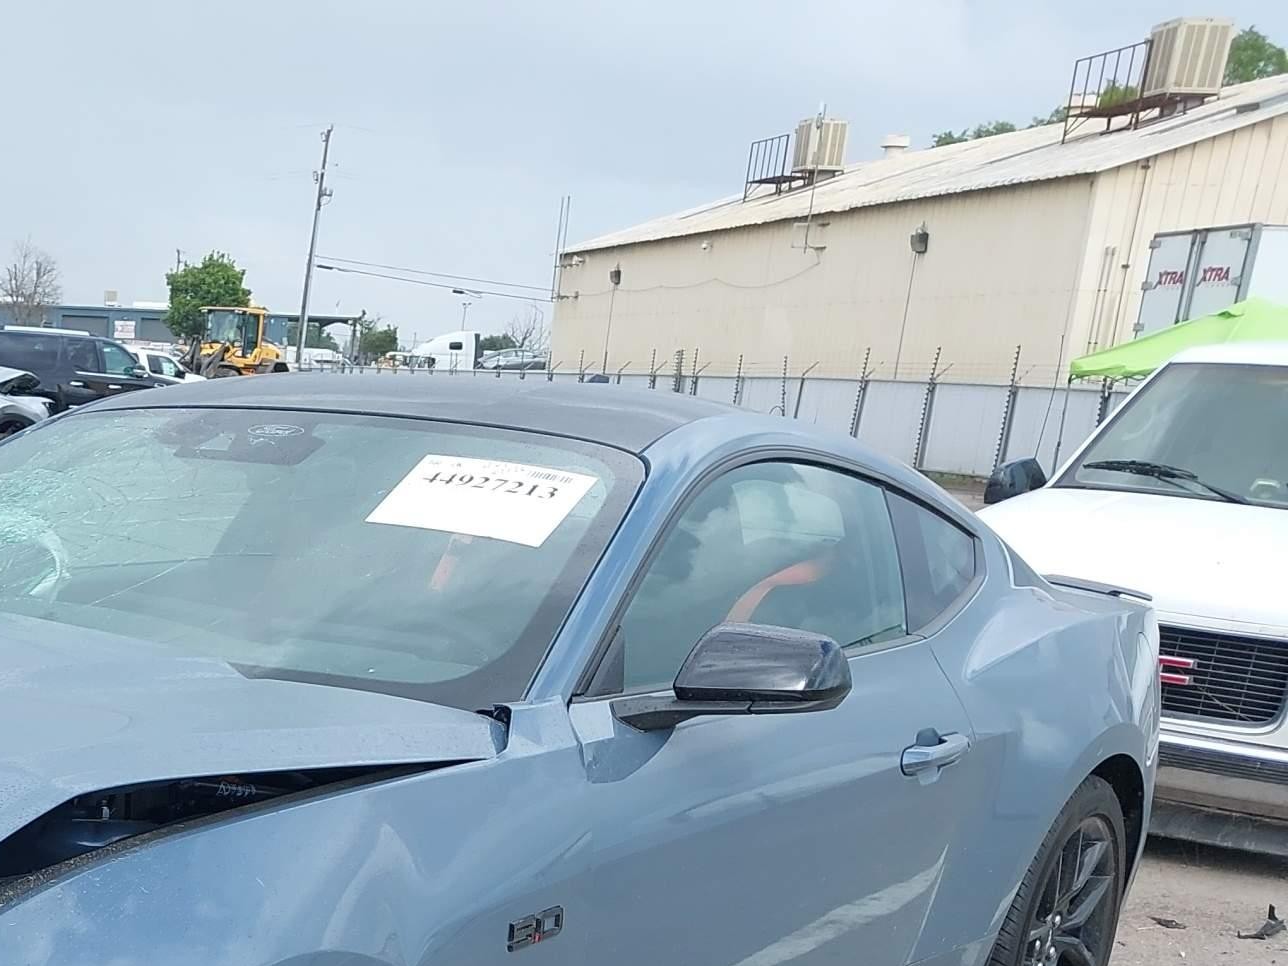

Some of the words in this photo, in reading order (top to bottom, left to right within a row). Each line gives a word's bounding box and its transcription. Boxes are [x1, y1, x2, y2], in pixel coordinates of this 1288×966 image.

[1153, 270, 1184, 289] XTRA
[1196, 266, 1231, 286] XTRA
[423, 472, 559, 499] 44927213
